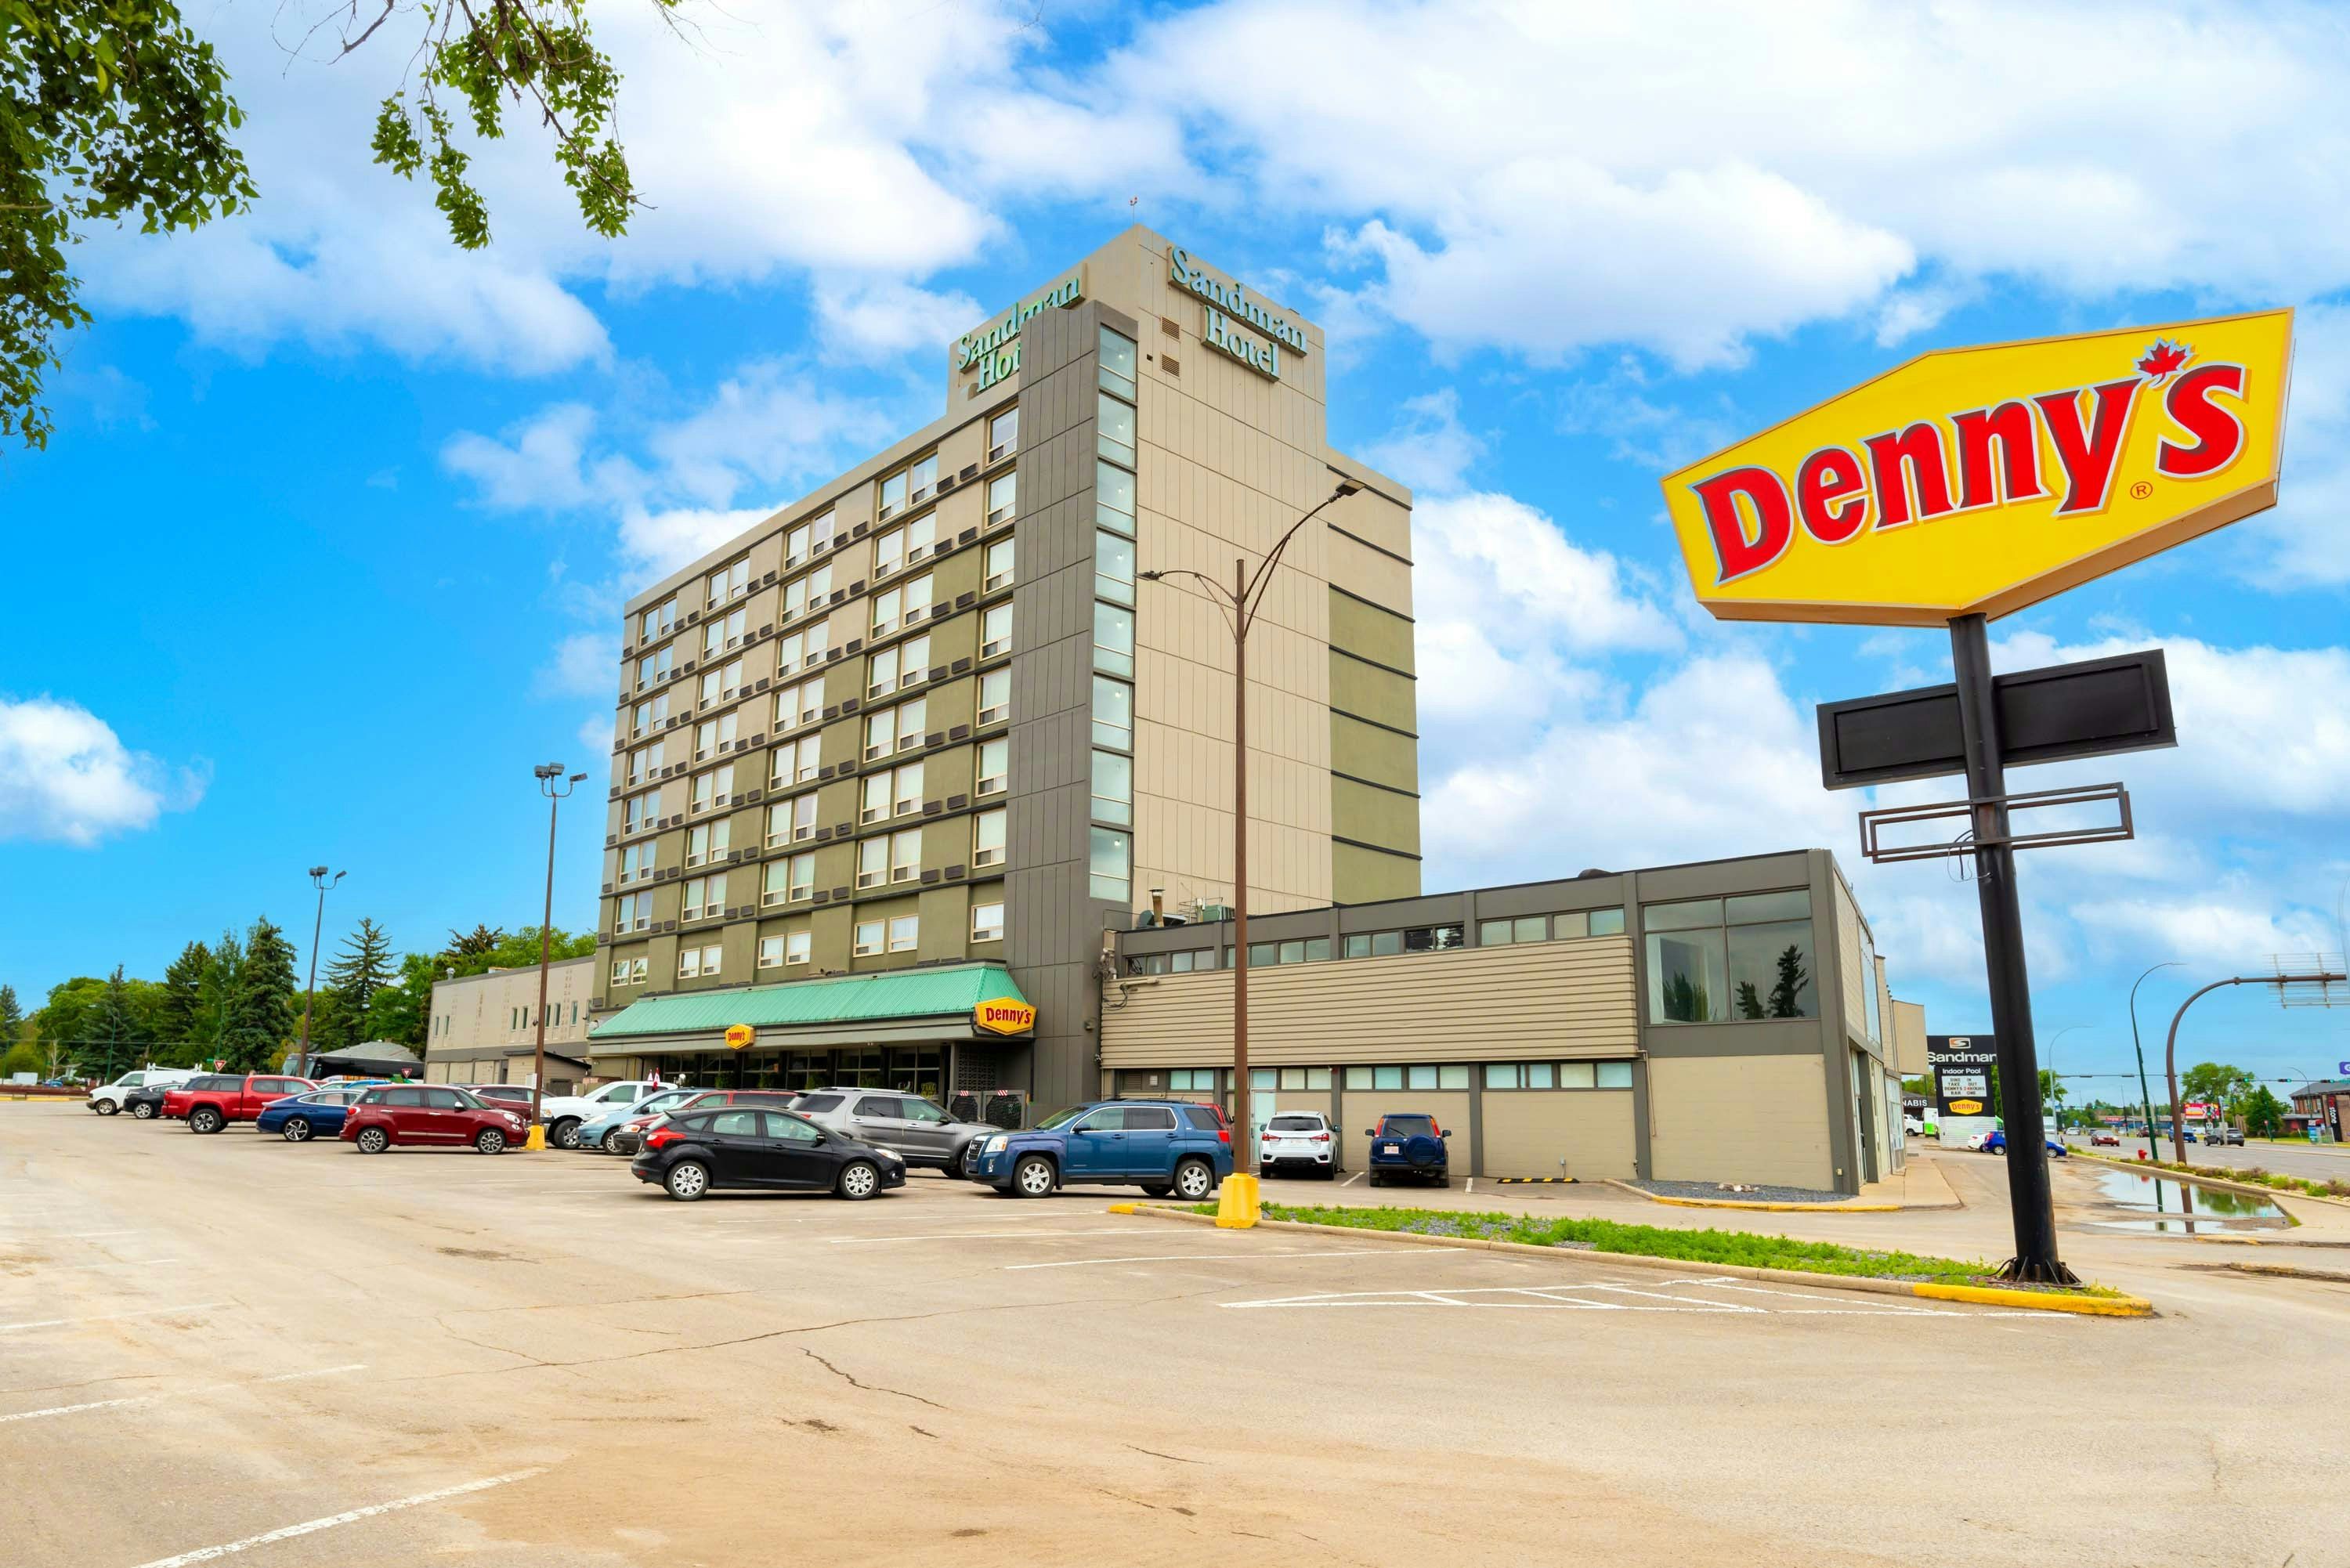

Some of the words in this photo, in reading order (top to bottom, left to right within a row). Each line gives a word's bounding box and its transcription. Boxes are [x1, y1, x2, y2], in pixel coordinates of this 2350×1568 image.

[1172, 247, 1309, 352] Sandman
[1206, 305, 1281, 378] Hotel
[1689, 338, 2246, 587] Denny's
[985, 1007, 1032, 1025] Denny's
